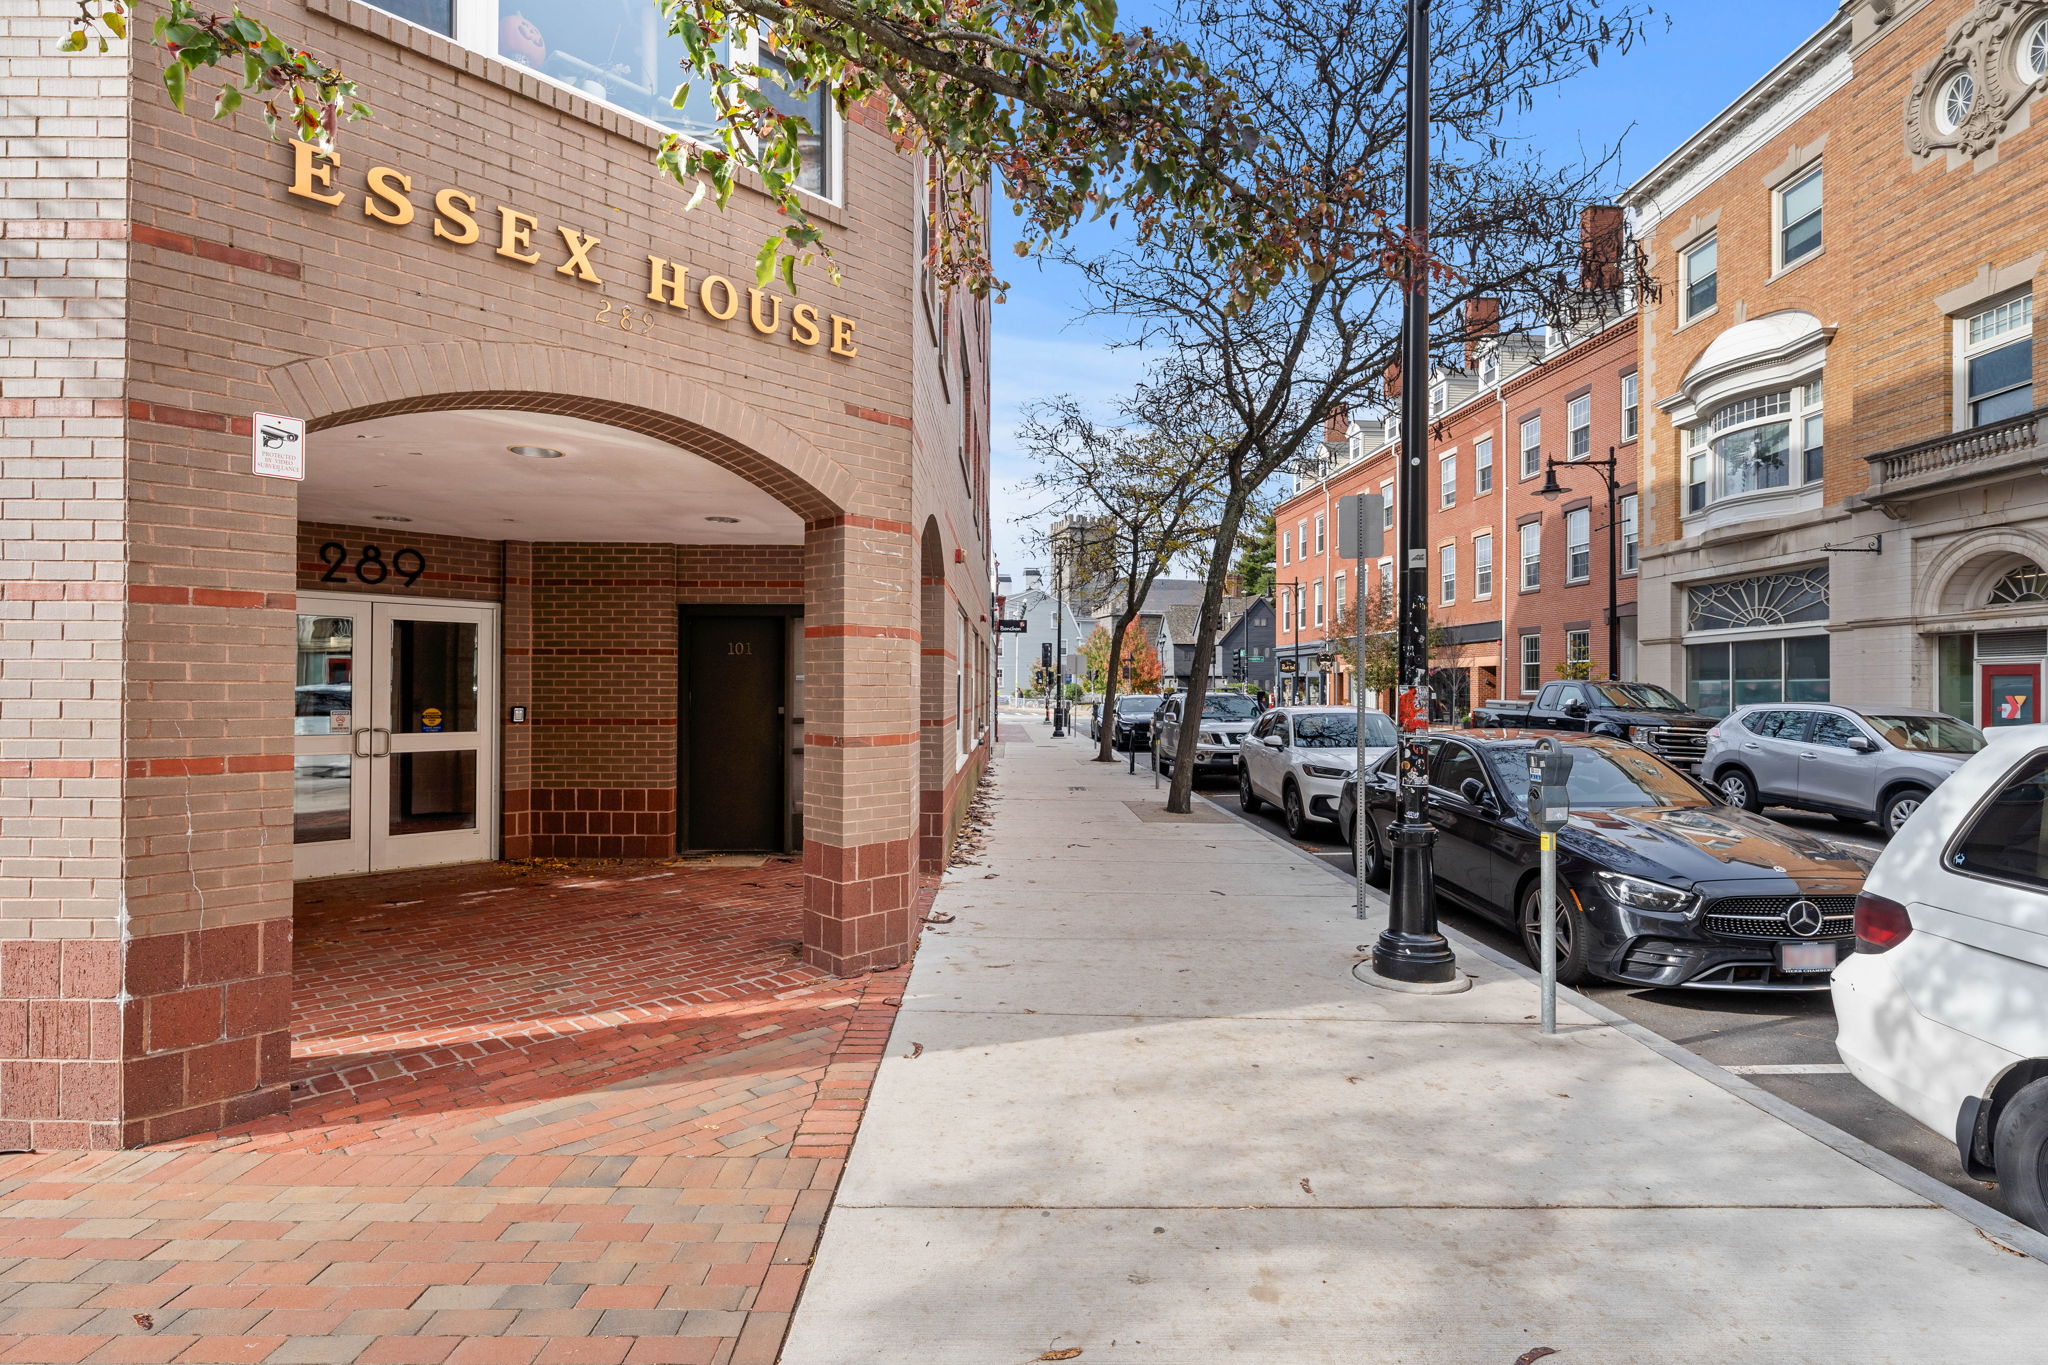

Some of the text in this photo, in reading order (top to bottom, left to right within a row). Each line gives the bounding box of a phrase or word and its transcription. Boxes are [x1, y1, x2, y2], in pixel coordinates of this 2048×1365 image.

[288, 138, 858, 358] ESSEX HOUSE
[594, 299, 655, 334] 289
[261, 451, 297, 460] PROTECTED
[319, 542, 426, 588] 289
[727, 642, 753, 655] 101
